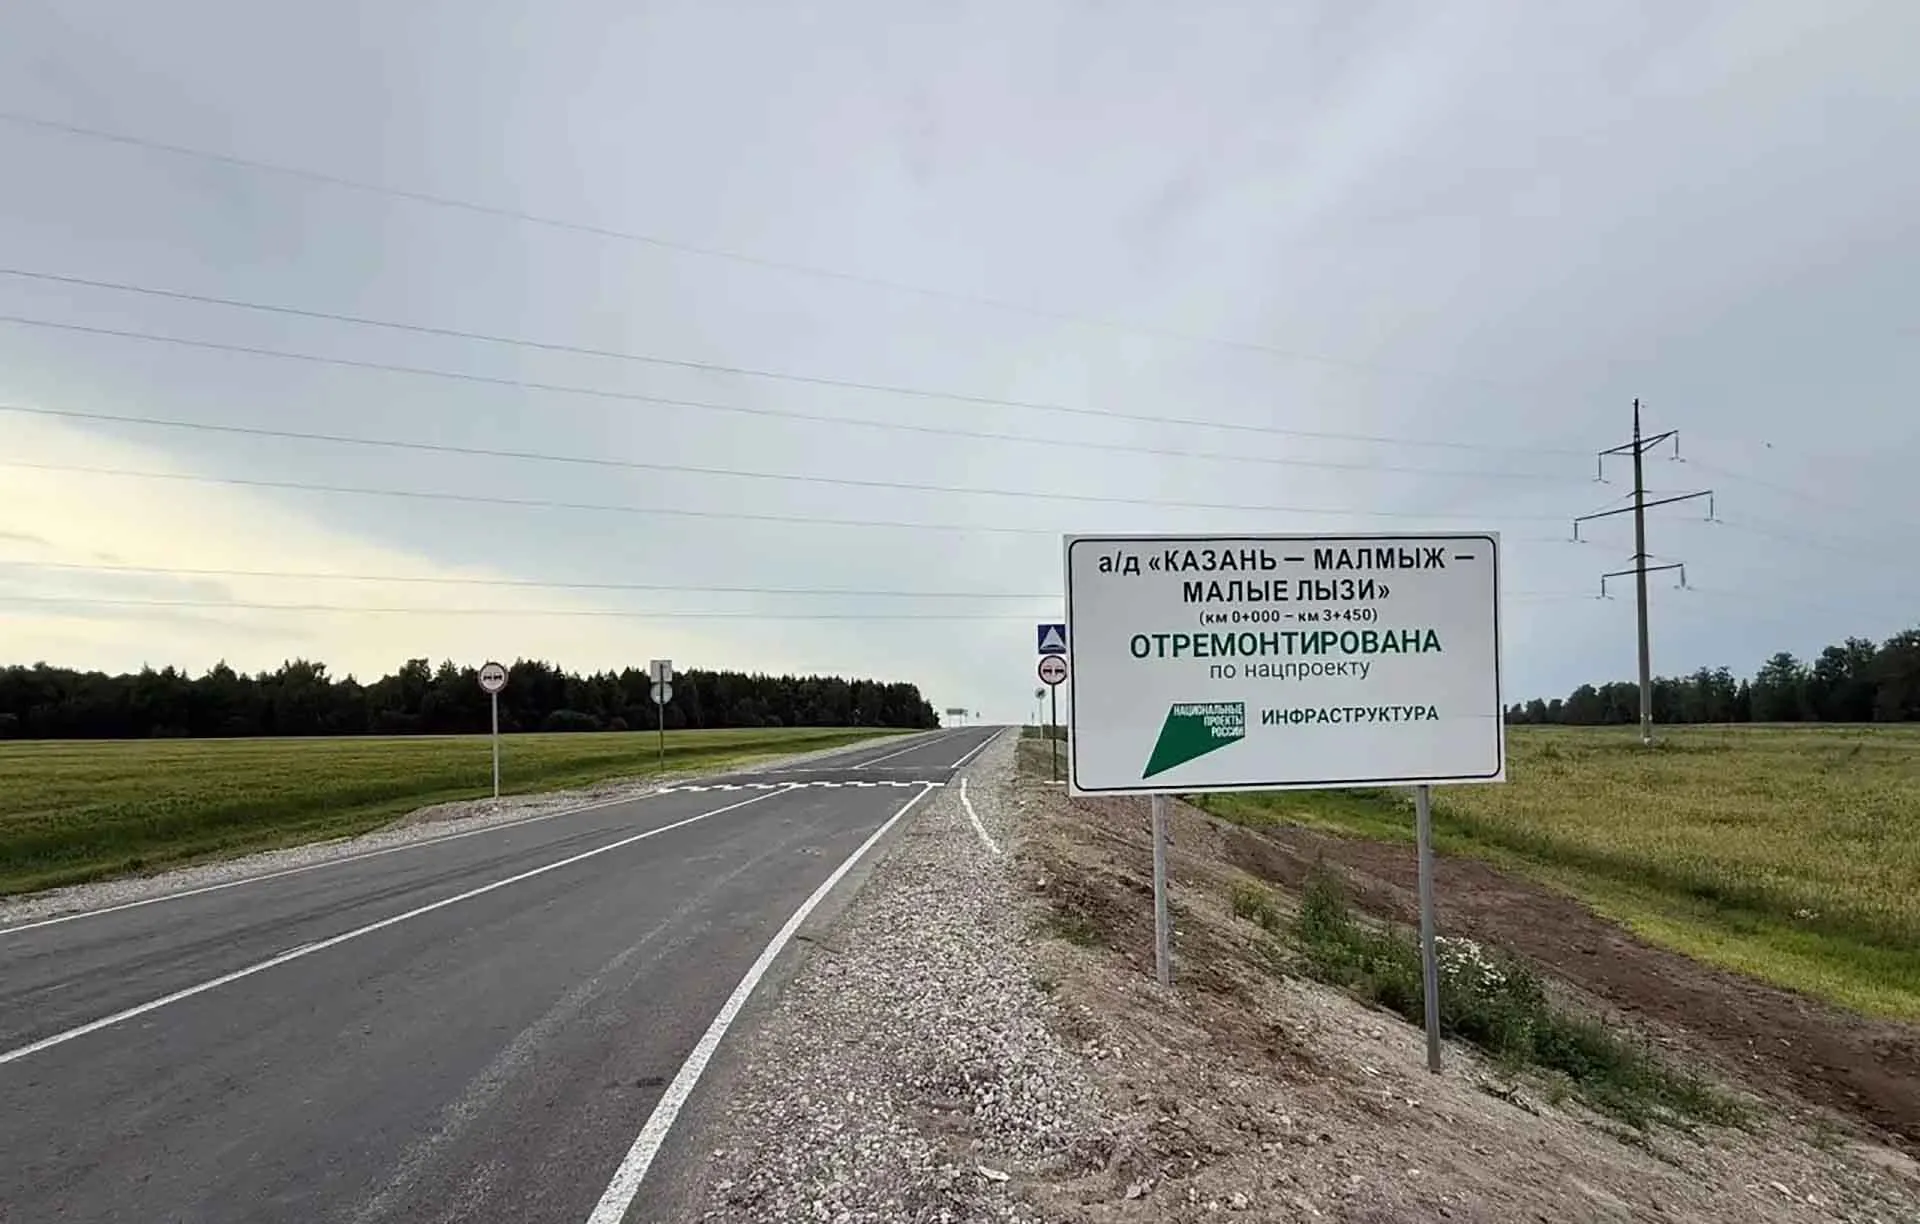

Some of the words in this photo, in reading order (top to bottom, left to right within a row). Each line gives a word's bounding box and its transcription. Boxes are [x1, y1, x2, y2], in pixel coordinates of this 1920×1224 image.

[1098, 551, 1140, 576] а/д
[1149, 549, 1277, 572] «КАЗАНЬ
[1314, 547, 1446, 570] МАЛМЫЖ
[1183, 580, 1289, 602] МАЛЫЕ
[1296, 579, 1390, 601] ЛЫЗИ»
[1199, 609, 1228, 626] (км
[1232, 609, 1280, 623] 0+000
[1299, 611, 1319, 622] км
[1322, 607, 1378, 624] 3+450)
[1130, 629, 1442, 658] ОТРЕМОНТИРОВАНА
[1210, 663, 1236, 679] по
[1244, 661, 1370, 681] нацпроекту
[1203, 714, 1243, 727] ПРОЕКТЫ
[1261, 705, 1439, 725] ИНФРАСТРУКТУРА
[1211, 726, 1244, 737] РОССИИ
